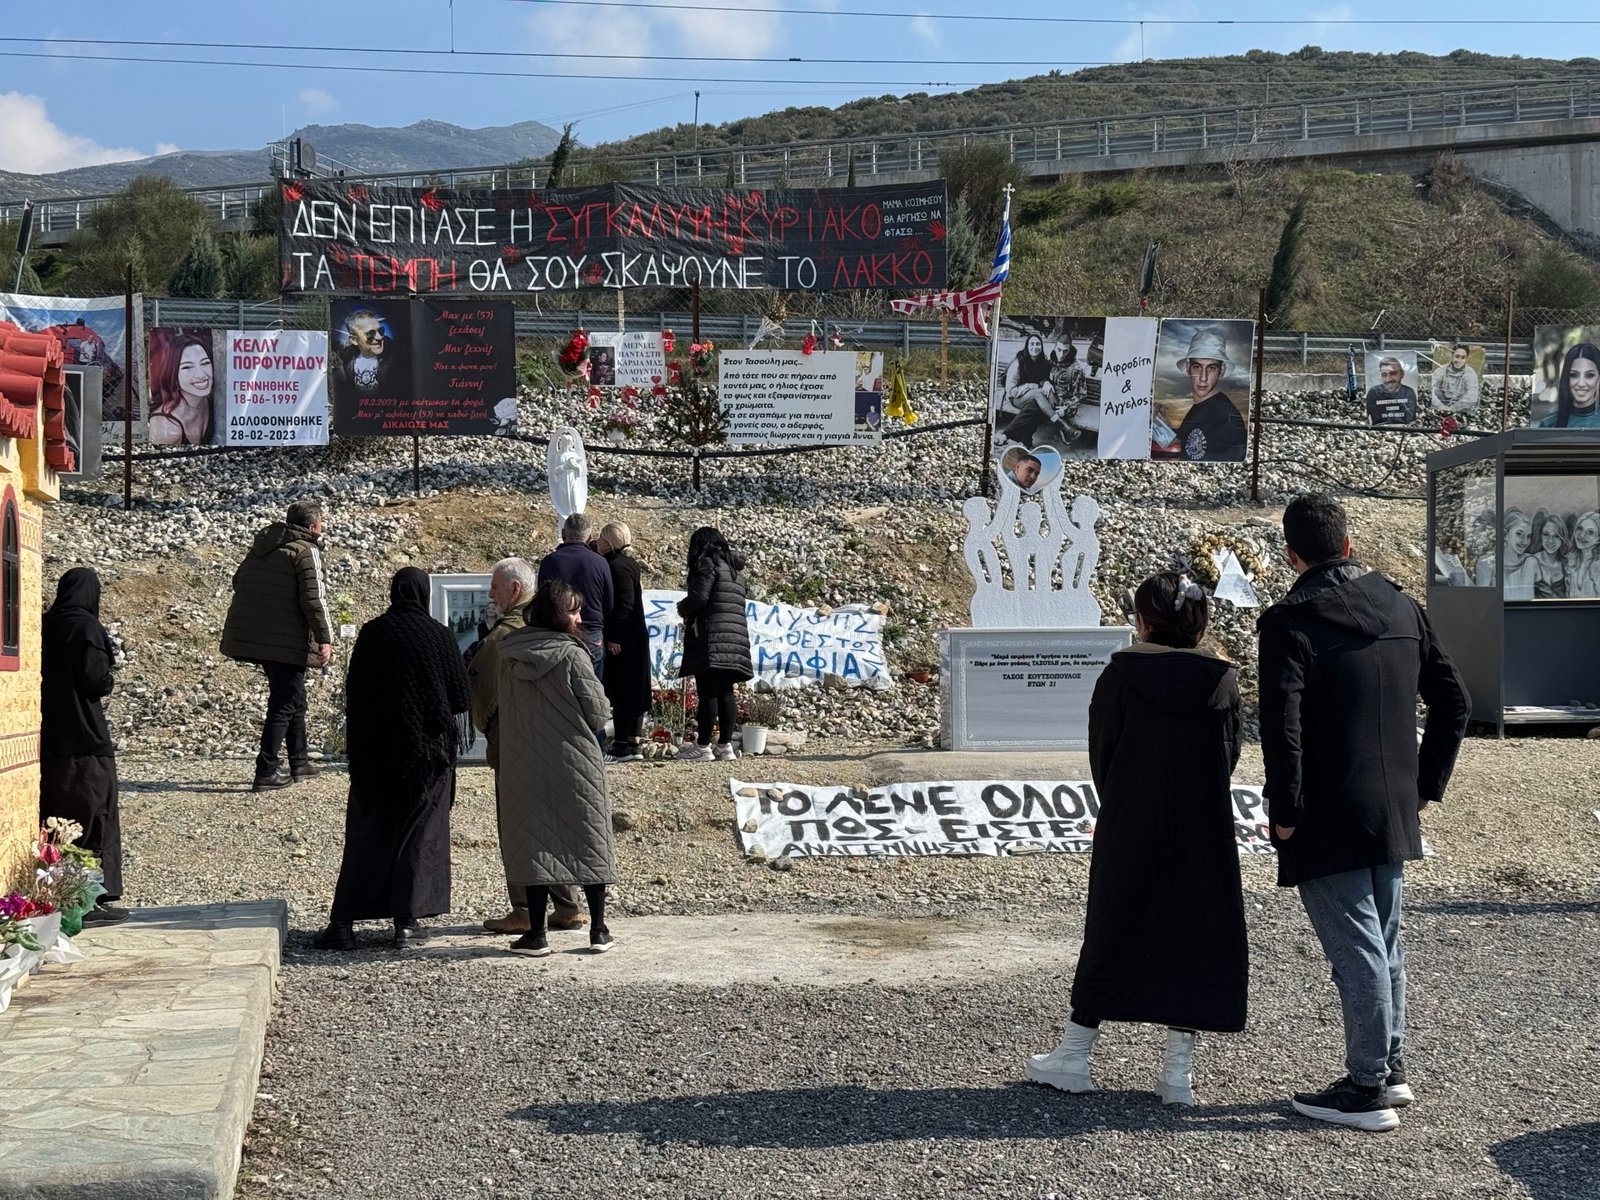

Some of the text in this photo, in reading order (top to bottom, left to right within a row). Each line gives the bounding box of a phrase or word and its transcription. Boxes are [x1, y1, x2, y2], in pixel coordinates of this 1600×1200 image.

[882, 195, 943, 209] ΜΑΜΑ ΚΟΙΜΗΣΟΥ
[884, 210, 942, 224] ΘΑ ΑΡΓΗΣΩ ΝΑ
[292, 200, 882, 246] ΔΕΝ ΕΠΙΑΣΕ Η ΣΥΓΚΑΛΥΨΗ ΚΥΡΙΑΚΟ
[292, 250, 934, 293] ΤΑ ΤΕΜΠΗ ΘΑ ΣΟΥ ΣΚΑΨΟΥΝΕ ΤΟ ΛΑΚΚΟ
[476, 310, 494, 320] (57)
[233, 338, 279, 352] ΚΕΛΛΥ
[233, 355, 324, 370] ΠΟΡΦΥΡΙΔΟΥ
[745, 358, 780, 366] Τασούλη
[1104, 356, 1151, 377] Αφροδίτη
[791, 372, 818, 381] πήραν
[233, 381, 299, 391] ΓΕΝΝΗΘΗΚΕ
[776, 382, 798, 390] ήλιος
[800, 382, 824, 390] έχασε
[1121, 379, 1132, 393] &
[234, 394, 297, 404] 18-06-1999
[734, 392, 752, 400] φως
[768, 391, 832, 401] εξαφανίστηκαν
[735, 402, 775, 410] χρώματα.
[231, 416, 323, 426] ΔΟΛΟΦΟΝΗΘΗΚΕ
[749, 412, 786, 420] αγαπάμε
[788, 412, 802, 420] για
[804, 412, 833, 420] πάντα!
[382, 421, 450, 429] ΔΙΚΑΙΩΣΕ ΜΑΣ
[734, 422, 759, 430] γονείς
[761, 422, 778, 430] σου,
[787, 422, 825, 430] αδερφός,
[231, 430, 296, 440] 28-02-2023
[824, 432, 851, 440] γιαγιά
[826, 786, 964, 816] ΛΕΝΕ
